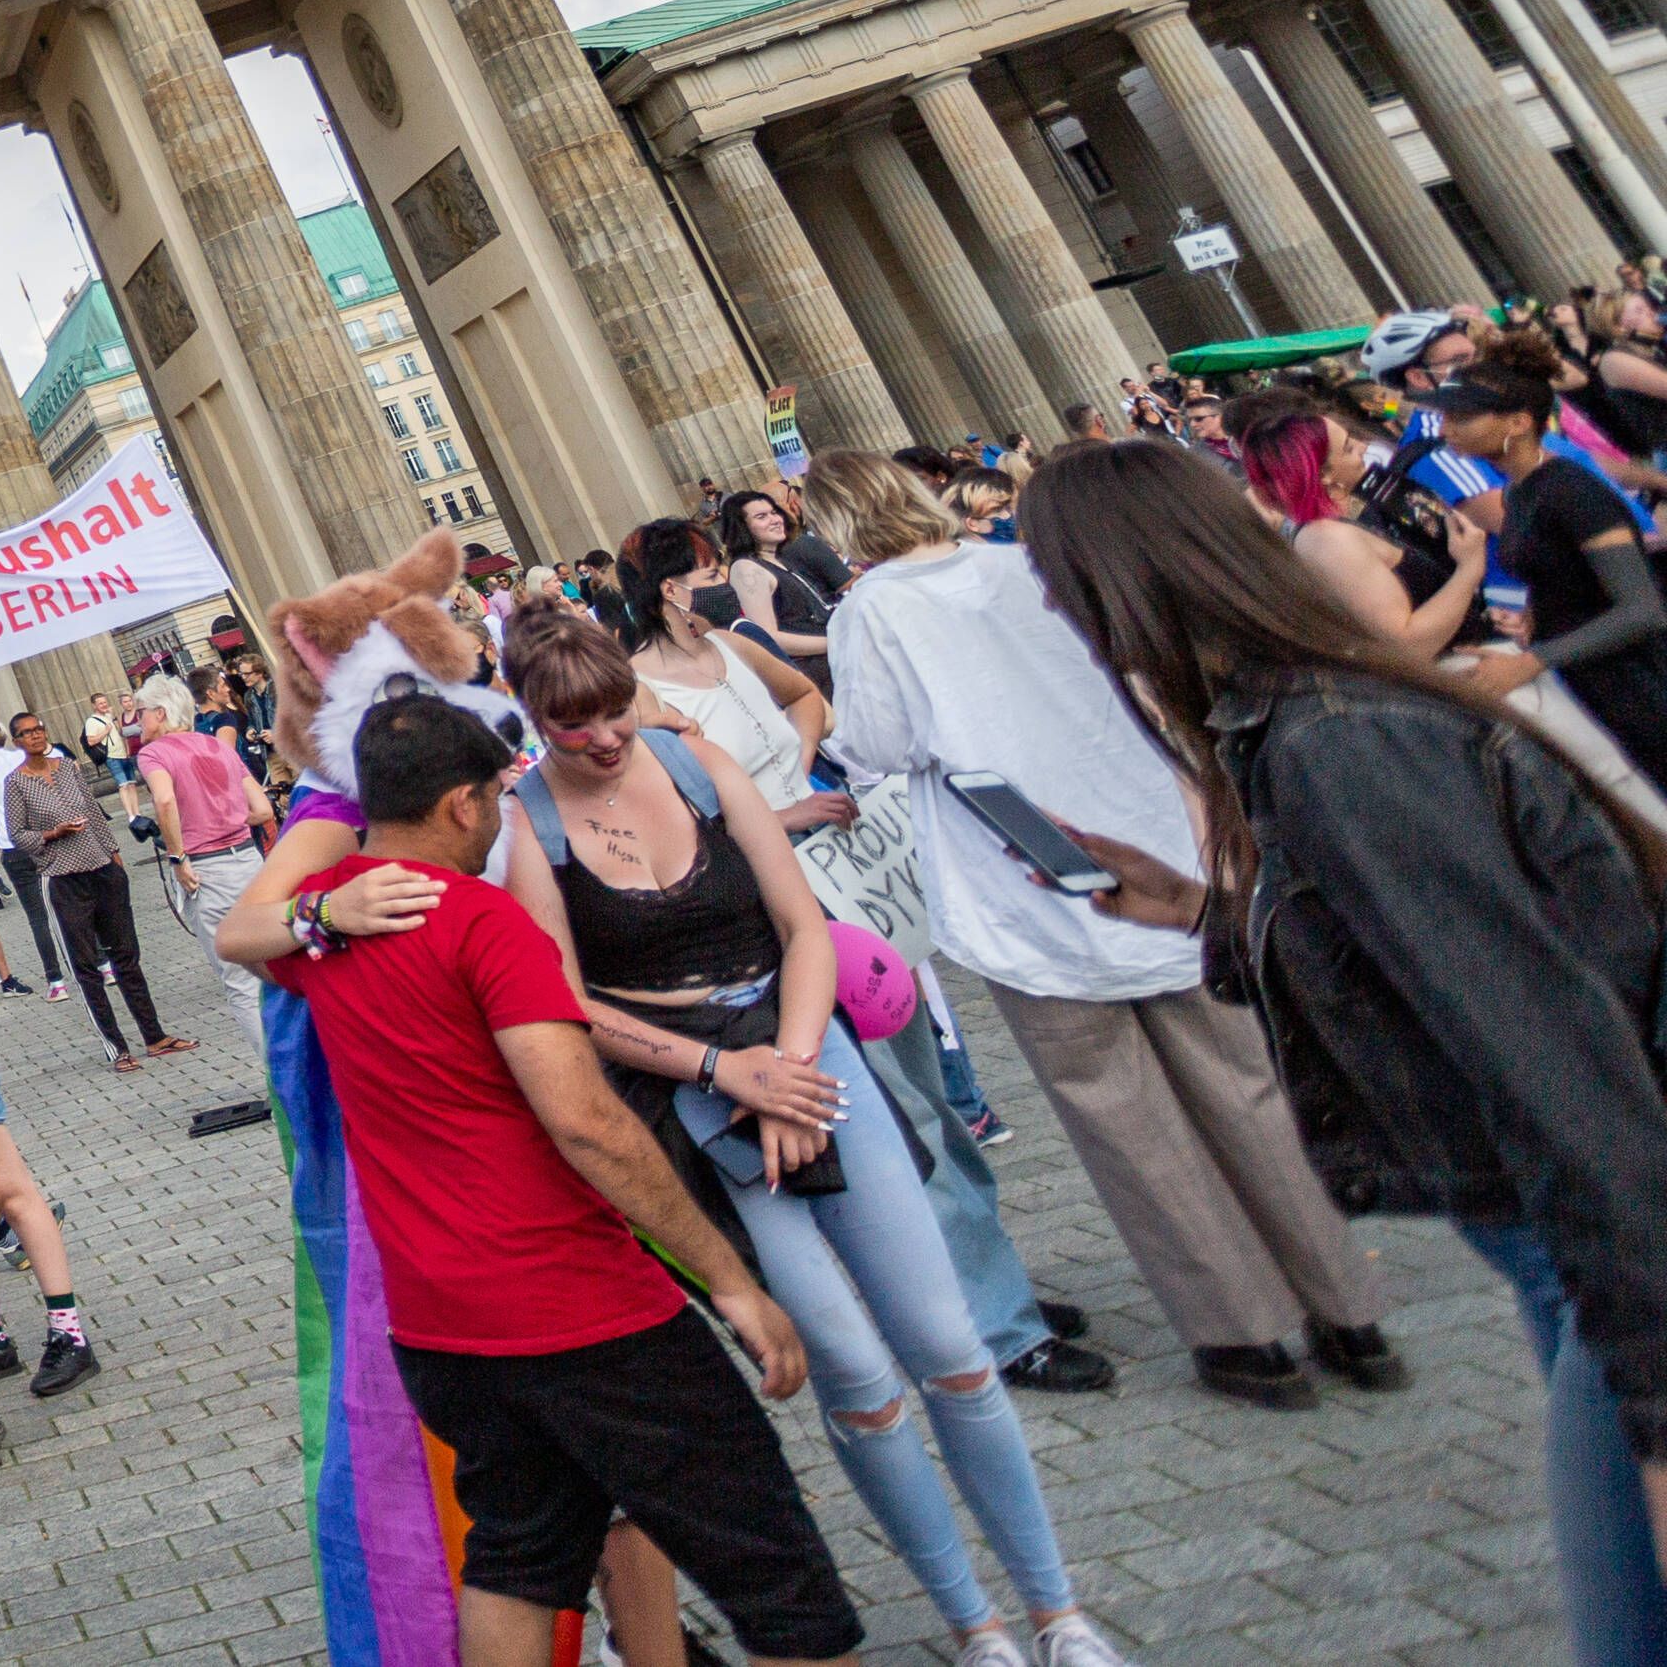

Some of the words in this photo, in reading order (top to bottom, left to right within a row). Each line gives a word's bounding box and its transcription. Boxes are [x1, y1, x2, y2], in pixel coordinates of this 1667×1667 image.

[770, 396, 792, 414] BLACK
[771, 437, 802, 458] MATTER
[584, 819, 638, 840] Free
[607, 840, 642, 865] Hugs
[854, 847, 926, 940] DYK
